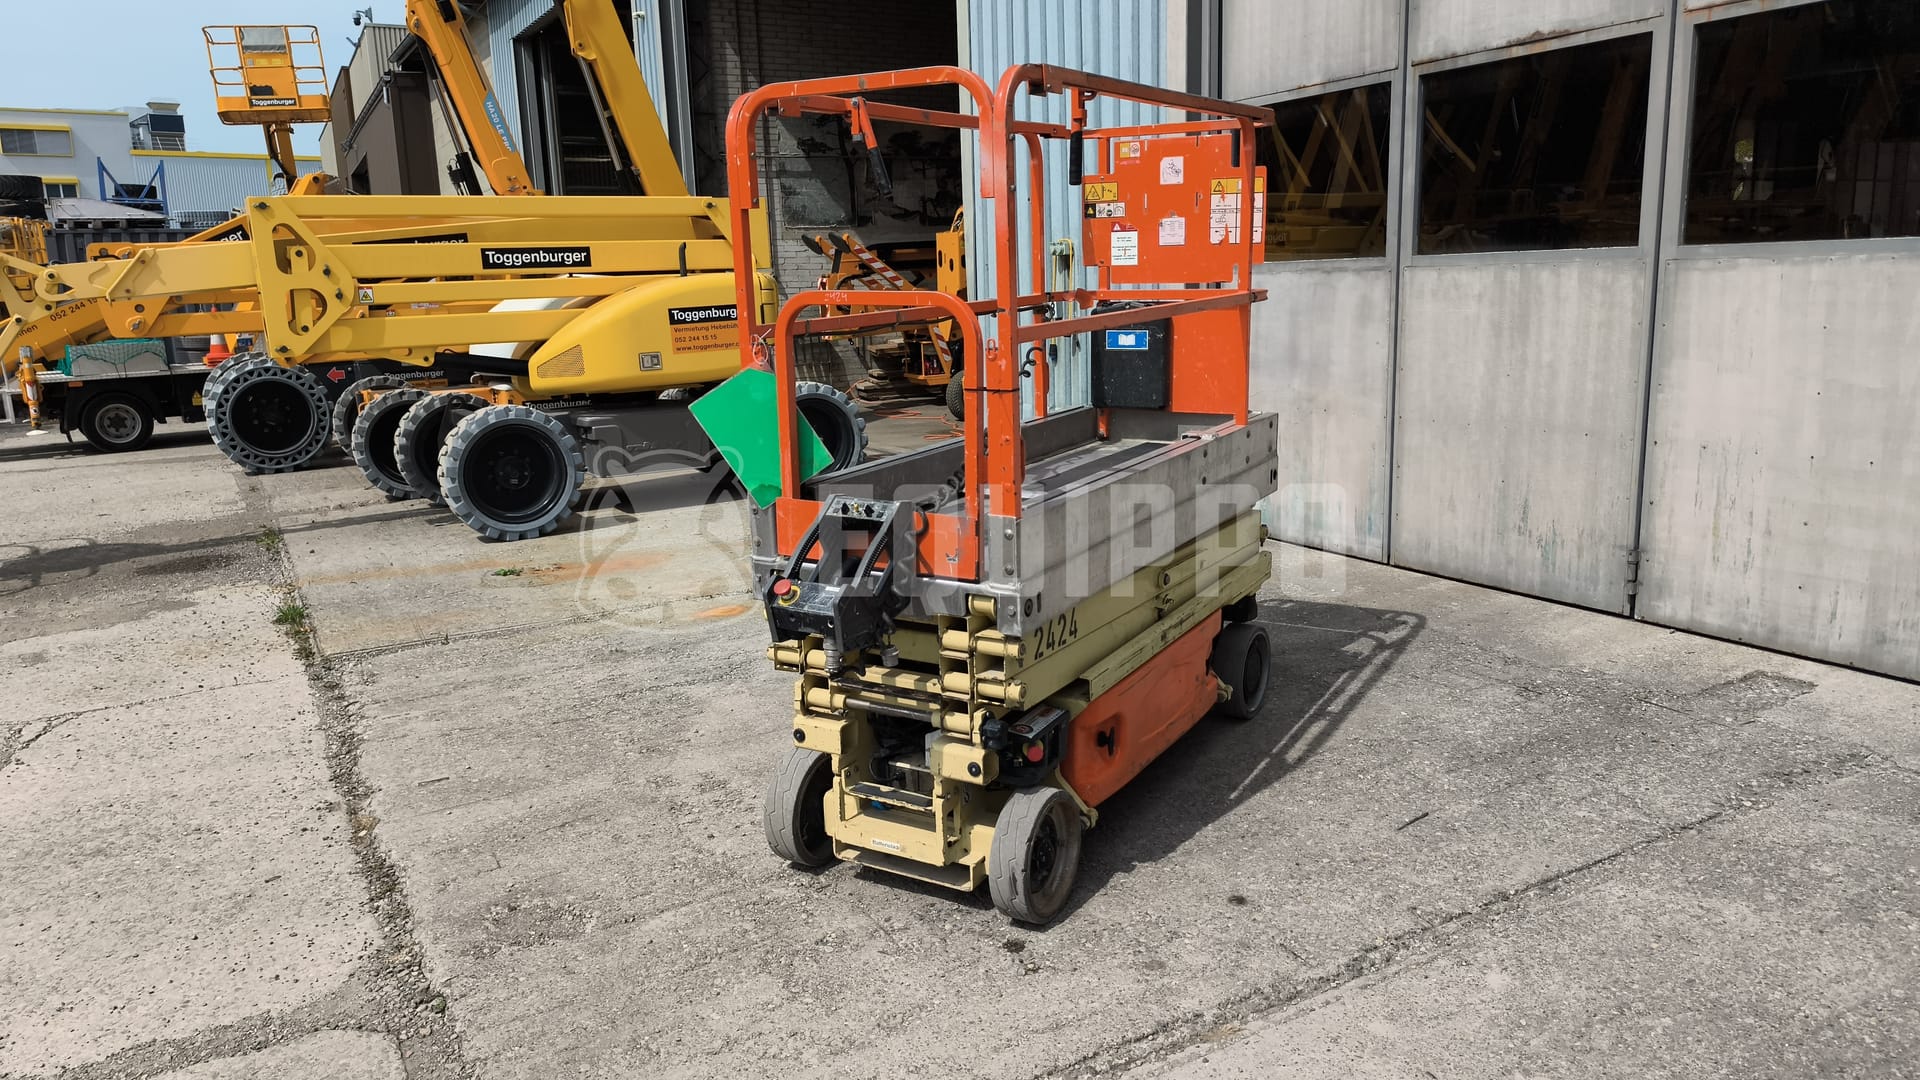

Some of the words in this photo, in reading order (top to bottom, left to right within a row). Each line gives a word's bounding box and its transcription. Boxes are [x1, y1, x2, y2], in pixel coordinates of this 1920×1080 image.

[251, 98, 296, 106] Toggenburger
[486, 101, 500, 123] HA20
[485, 250, 588, 266] Toggenburger
[49, 309, 67, 322] 052
[69, 302, 86, 314] 244
[671, 308, 737, 322] Toggenburg
[673, 325, 710, 333] Vermietung
[384, 370, 444, 382] Toggenburger
[1034, 607, 1078, 661] 2424
